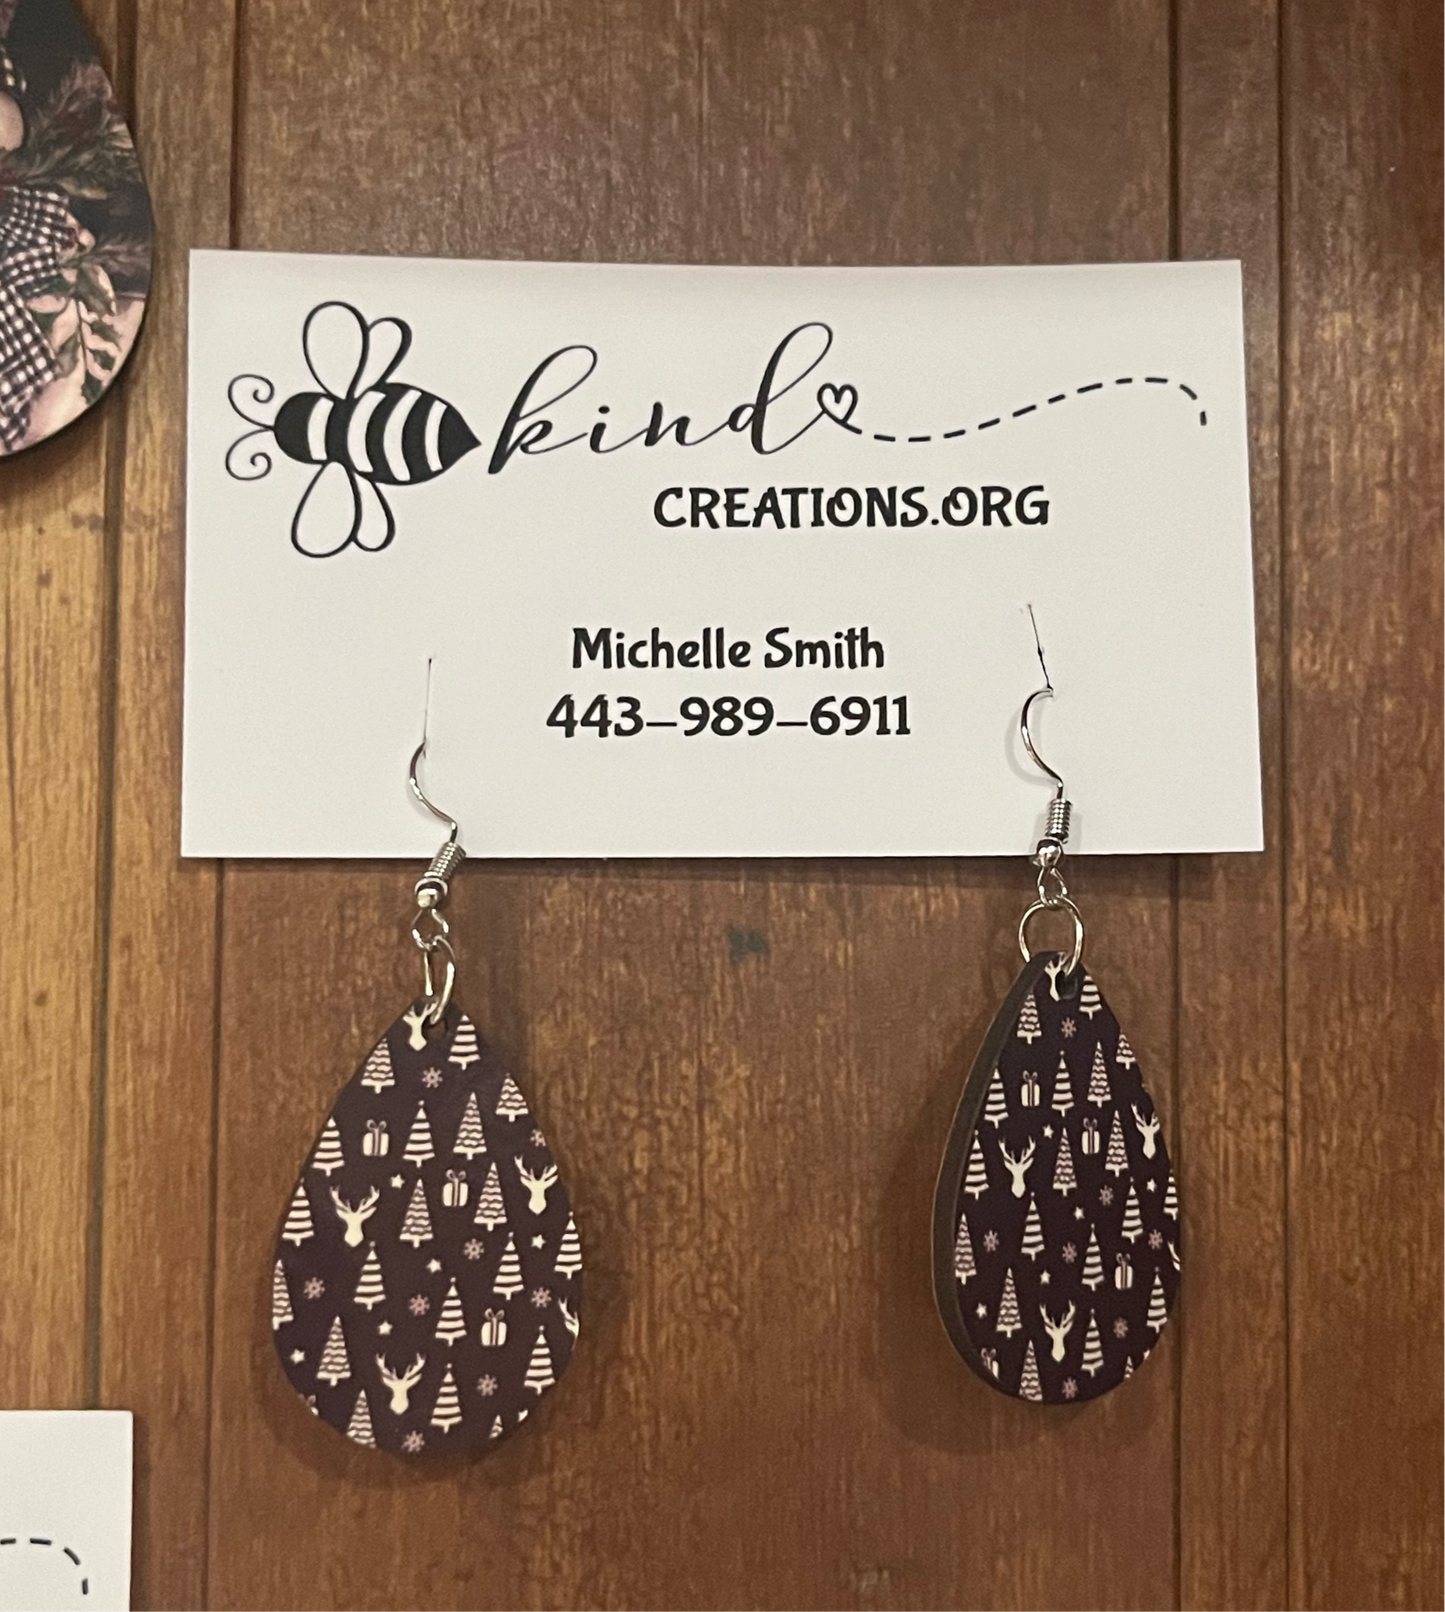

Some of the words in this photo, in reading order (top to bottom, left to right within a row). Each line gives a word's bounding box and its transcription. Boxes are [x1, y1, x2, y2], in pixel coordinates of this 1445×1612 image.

[487, 322, 834, 475] kind
[653, 485, 1050, 530] CREATIONS.ORG
[572, 626, 754, 670] Michelle
[764, 626, 885, 670] Smith
[546, 694, 912, 738] 443-989-6911
